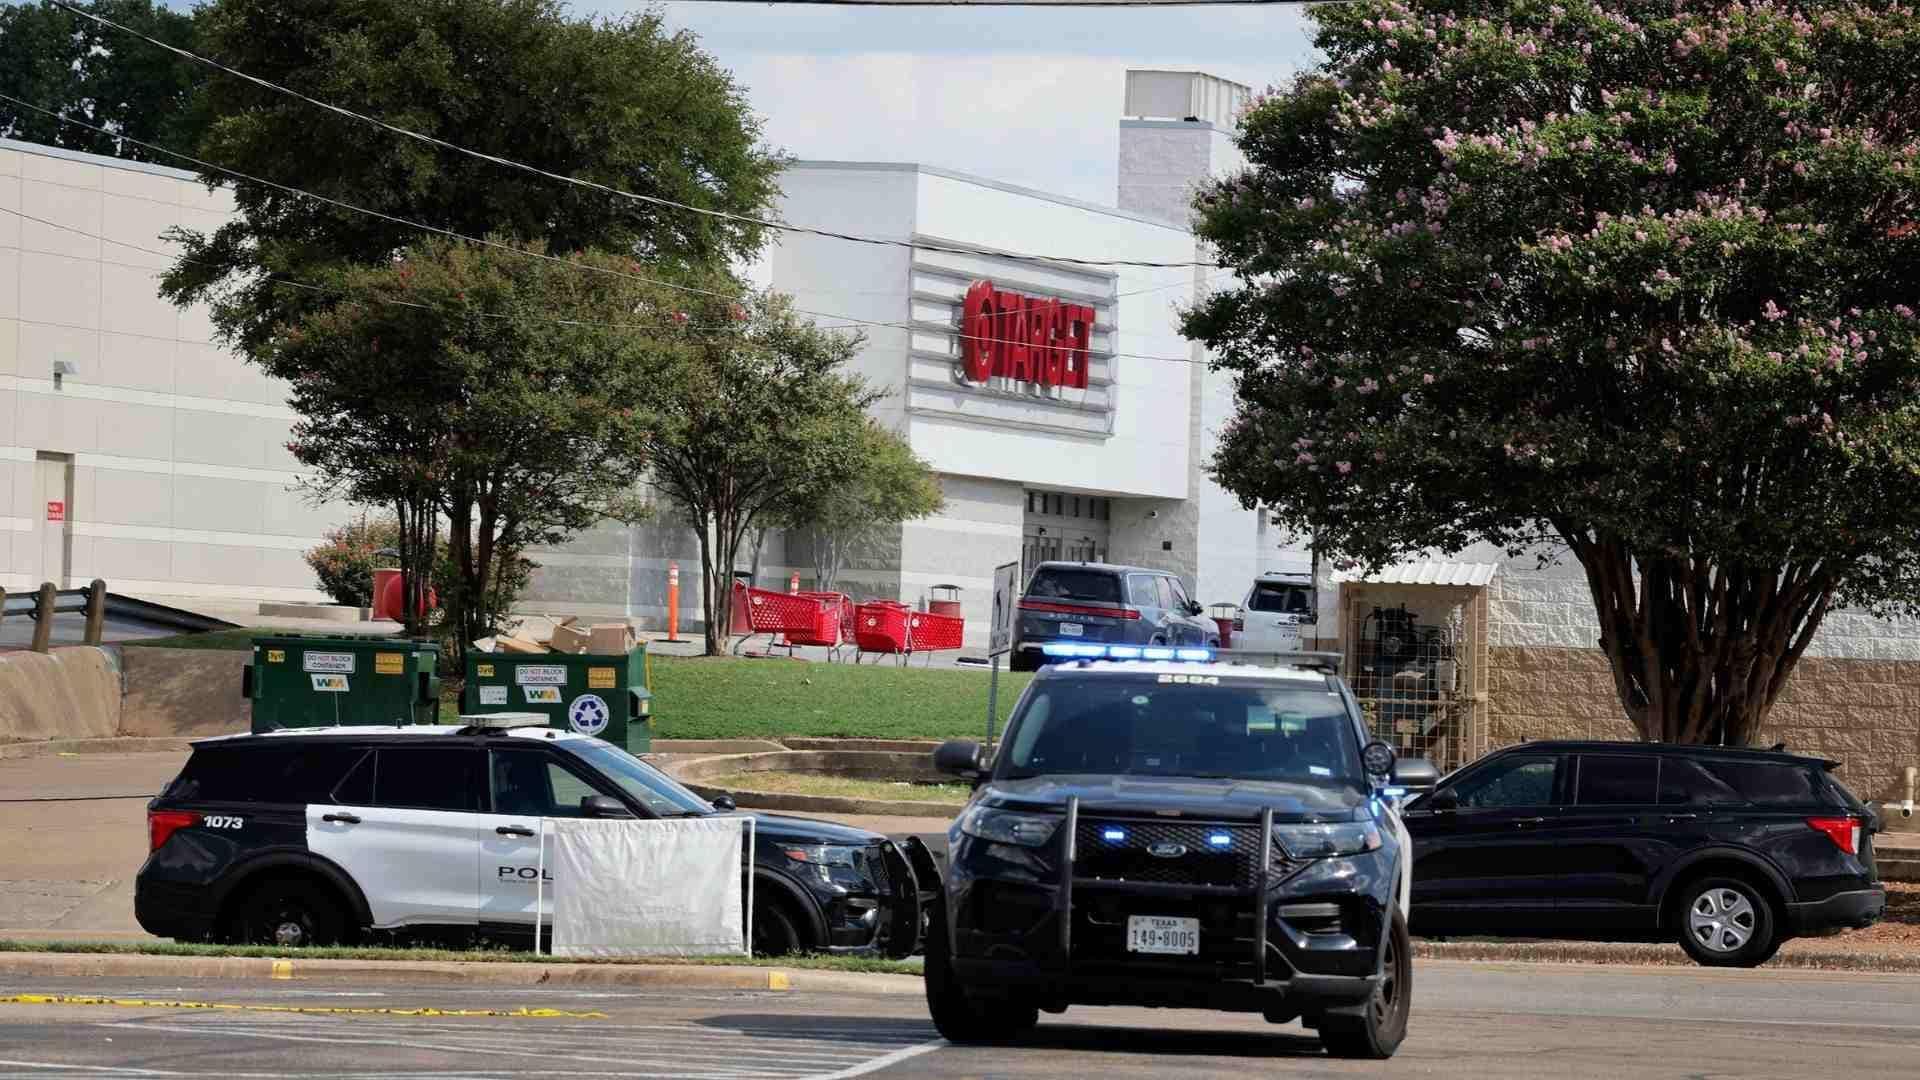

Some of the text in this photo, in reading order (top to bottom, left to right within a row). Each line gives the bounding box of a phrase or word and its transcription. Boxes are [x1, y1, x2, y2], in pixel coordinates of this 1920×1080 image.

[996, 289, 1096, 390] TARGET
[316, 678, 345, 688] WM
[529, 690, 557, 699] WM
[203, 815, 244, 829] 1073
[499, 866, 554, 881] POL
[1151, 919, 1178, 927] TEXAS
